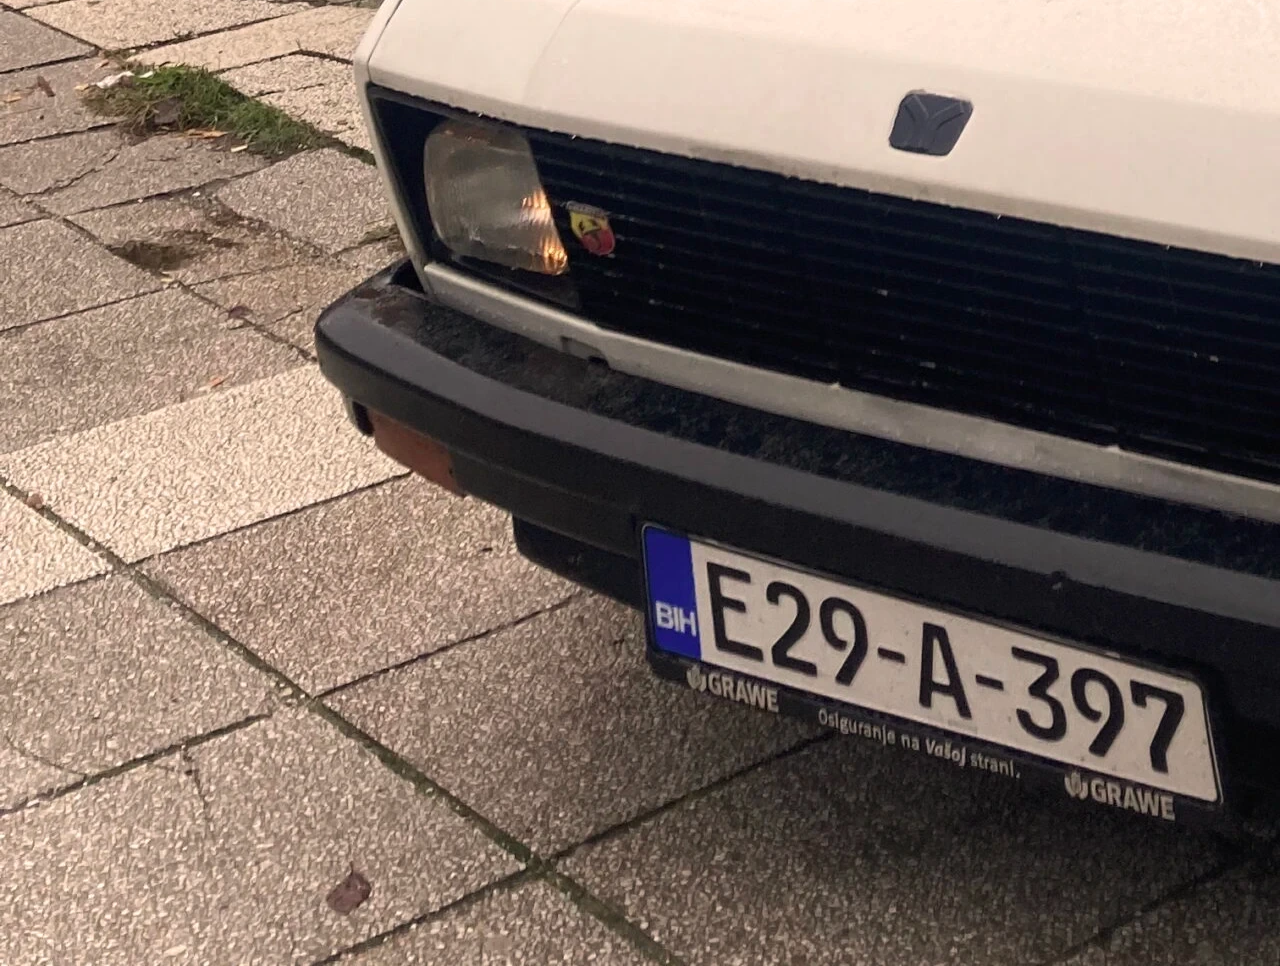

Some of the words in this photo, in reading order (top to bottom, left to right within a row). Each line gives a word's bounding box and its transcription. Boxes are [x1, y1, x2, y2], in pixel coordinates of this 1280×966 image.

[655, 600, 697, 637] BIH
[706, 561, 1186, 774] E29-A-397
[708, 671, 779, 713] GRAWE
[818, 708, 896, 745] Osiguranje
[901, 733, 920, 751] na
[925, 738, 967, 767] Vašoj
[1090, 777, 1176, 822] GRAWE
